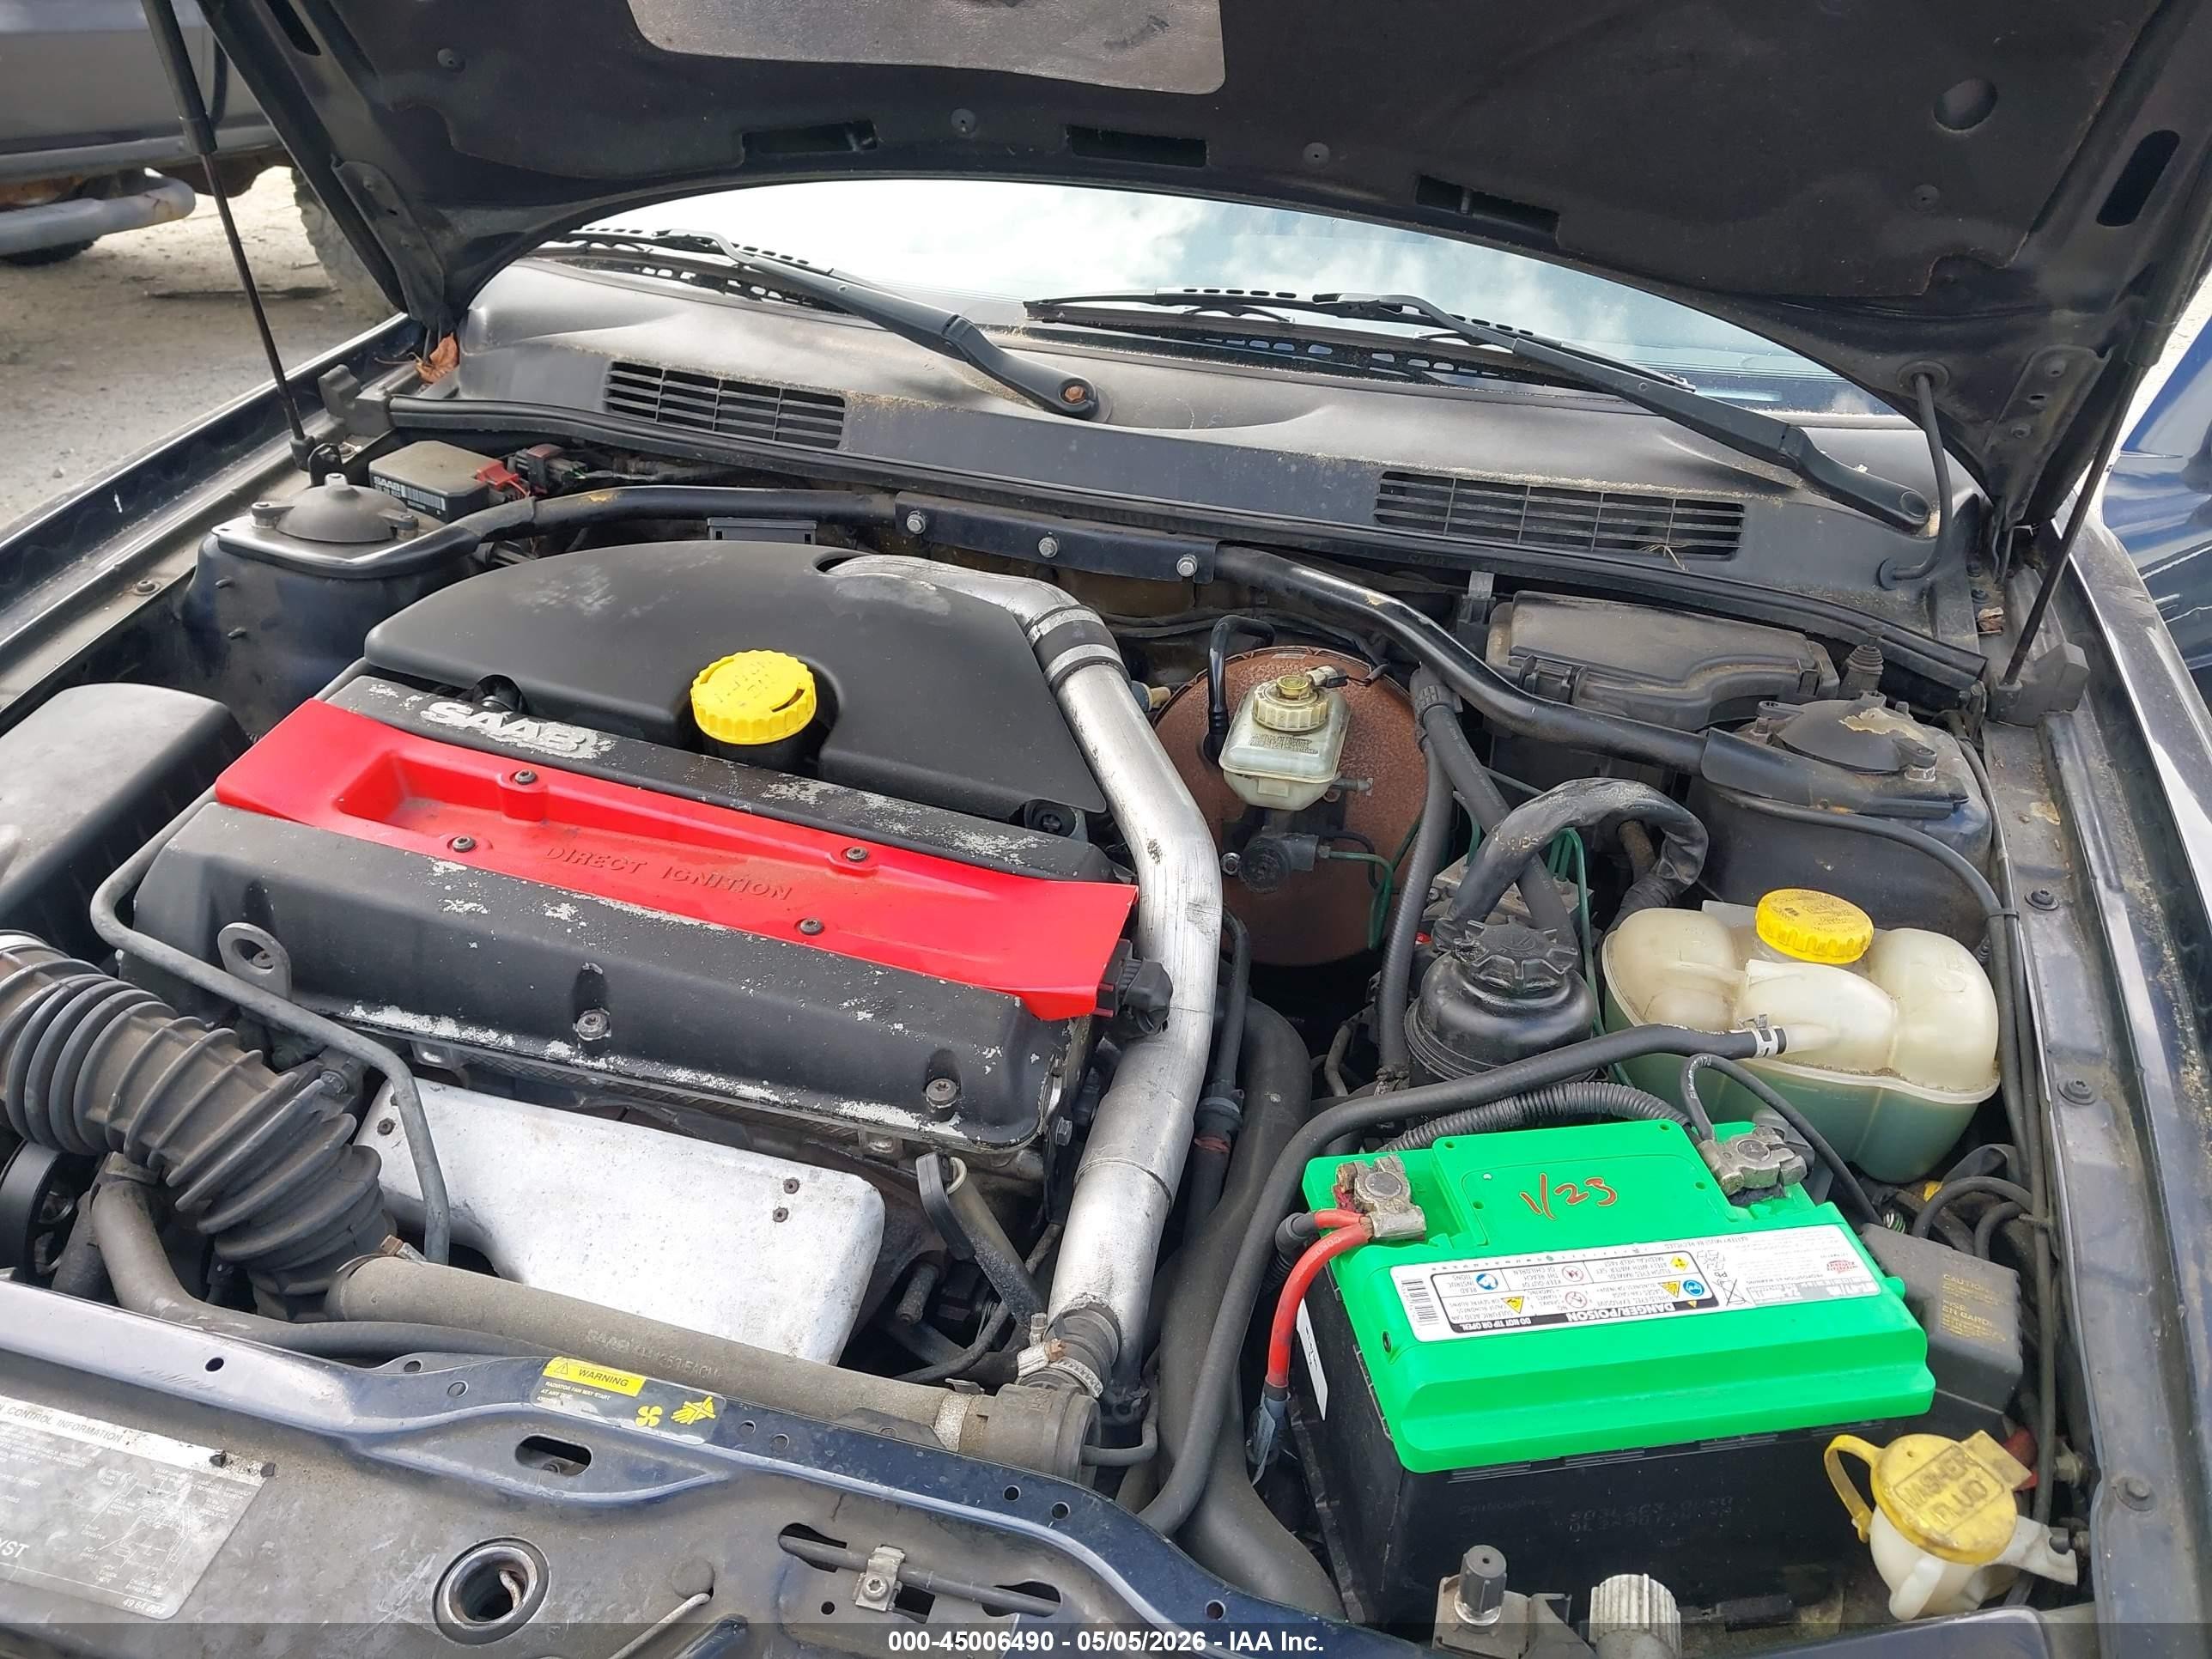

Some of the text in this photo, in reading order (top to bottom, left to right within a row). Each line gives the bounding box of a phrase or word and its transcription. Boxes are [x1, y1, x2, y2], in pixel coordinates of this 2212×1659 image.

[420, 702, 587, 752] SAAB
[545, 847, 793, 901] DIRECT IGNITION
[1520, 1173, 1618, 1219] 1/23
[1459, 1322, 1480, 1330] OPEN.
[1566, 1304, 1675, 1322] DANGER/POISON
[544, 1379, 571, 1391] RADIATOR
[593, 1391, 611, 1401] START
[579, 1368, 630, 1388] WARNING
[7, 1407, 53, 1425] CONTROL
[57, 1418, 123, 1443] INFORMATION
